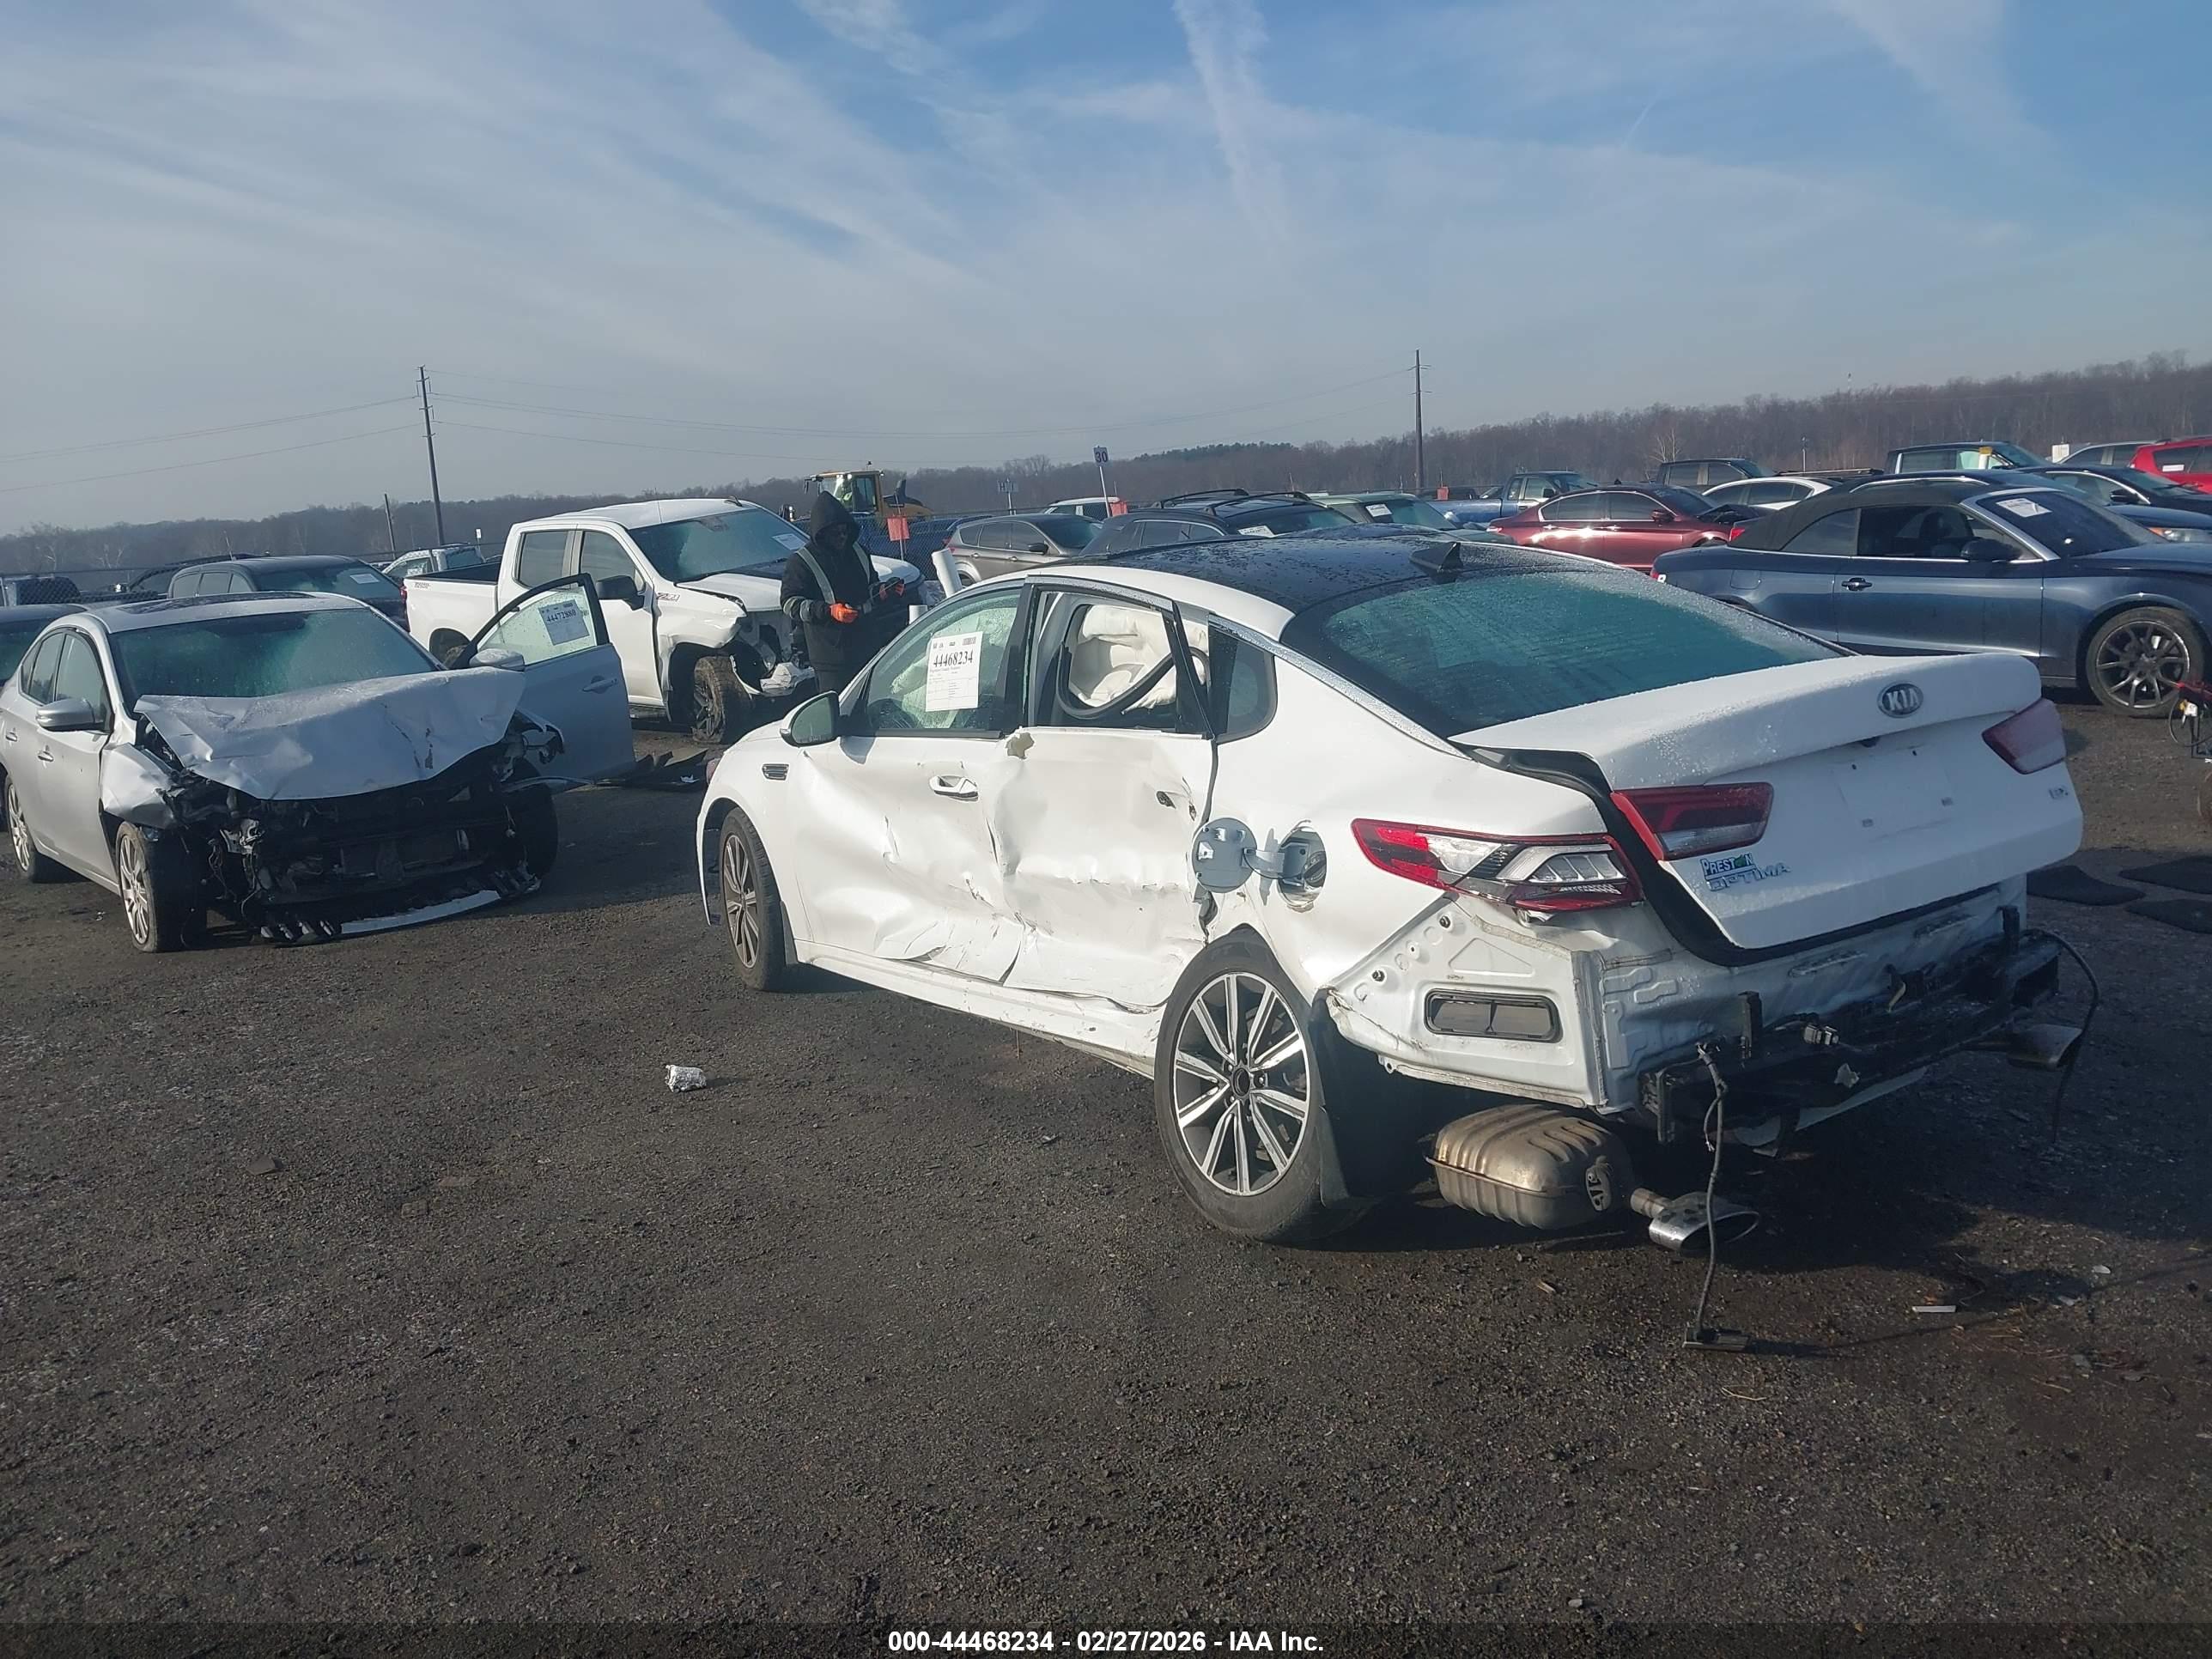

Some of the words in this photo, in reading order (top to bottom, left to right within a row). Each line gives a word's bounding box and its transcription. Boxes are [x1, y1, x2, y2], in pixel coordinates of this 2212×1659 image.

[1094, 451, 1108, 463] 30
[933, 648, 974, 667] 44468234
[1886, 688, 1920, 711] KIA
